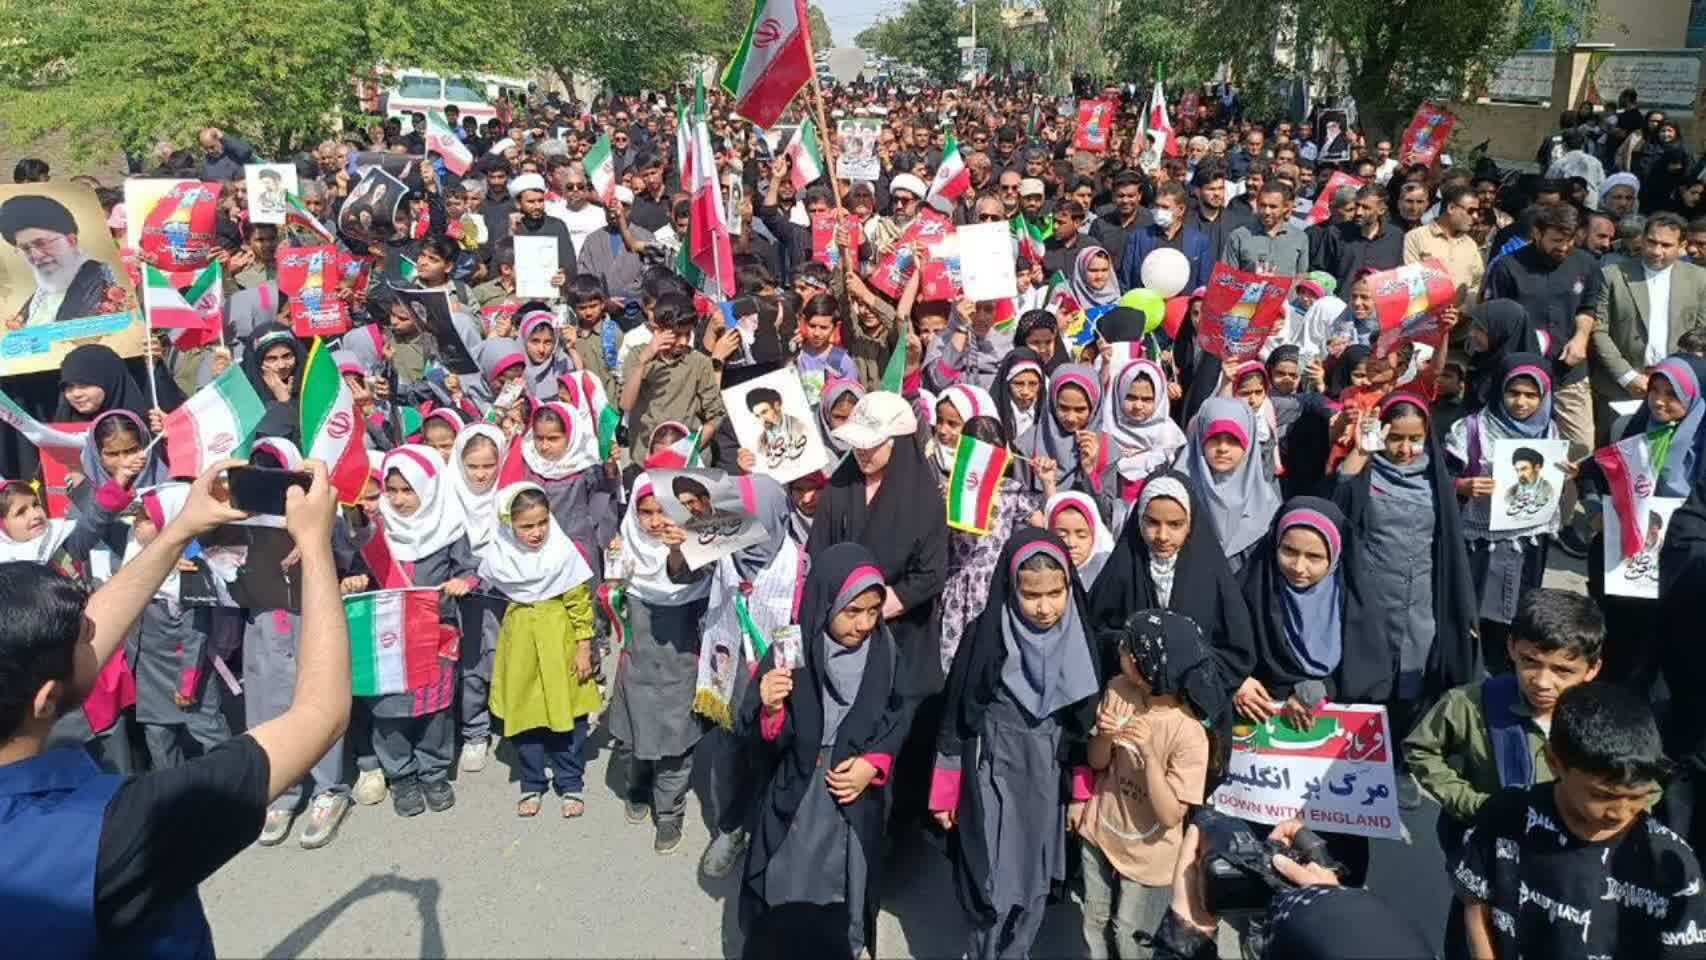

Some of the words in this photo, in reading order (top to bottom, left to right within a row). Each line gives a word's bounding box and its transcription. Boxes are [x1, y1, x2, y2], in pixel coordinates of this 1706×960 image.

[1300, 775, 1321, 801] بر
[1328, 772, 1389, 806] مرگ
[1219, 793, 1261, 813] DOWN
[1265, 804, 1305, 820] WITH
[1311, 808, 1392, 829] ENGLAND
